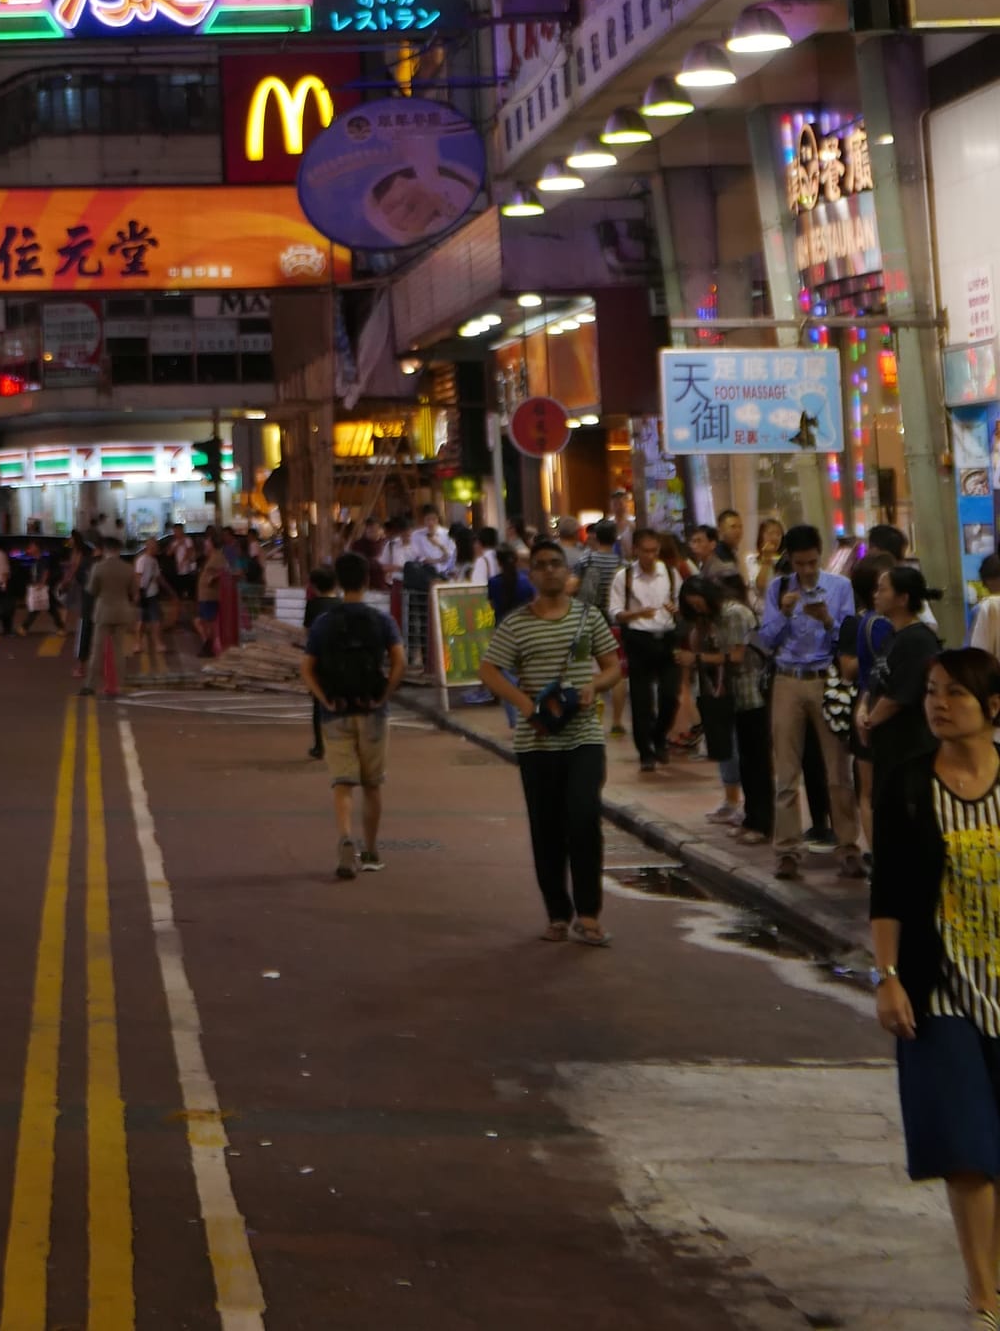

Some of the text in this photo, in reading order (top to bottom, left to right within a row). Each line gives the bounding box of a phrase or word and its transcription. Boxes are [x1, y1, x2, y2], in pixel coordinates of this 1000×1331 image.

[330, 7, 441, 31] レストラン
[714, 384, 787, 401] FOOT MASSAGE
